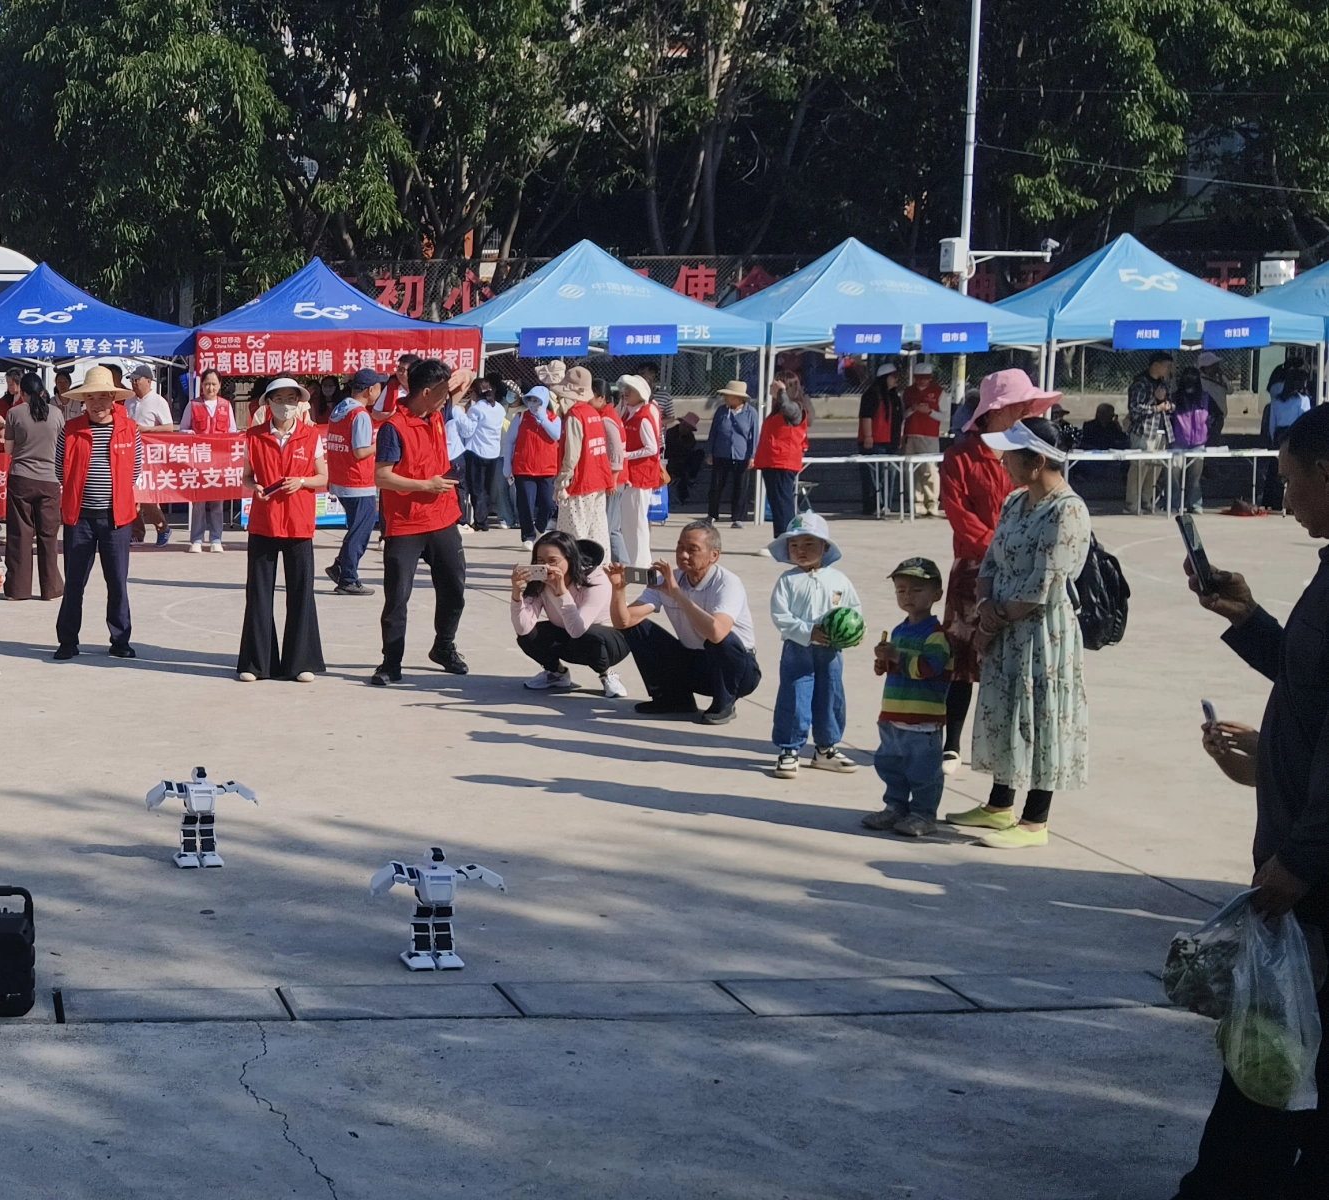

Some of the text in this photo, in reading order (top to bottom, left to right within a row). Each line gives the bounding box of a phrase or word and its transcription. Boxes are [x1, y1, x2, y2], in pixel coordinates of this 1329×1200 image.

[8, 338, 56, 354] 看移动
[65, 338, 145, 354] 智享全千兆
[199, 349, 333, 374] 远离电信网络诈骗
[140, 443, 212, 465] 团结情
